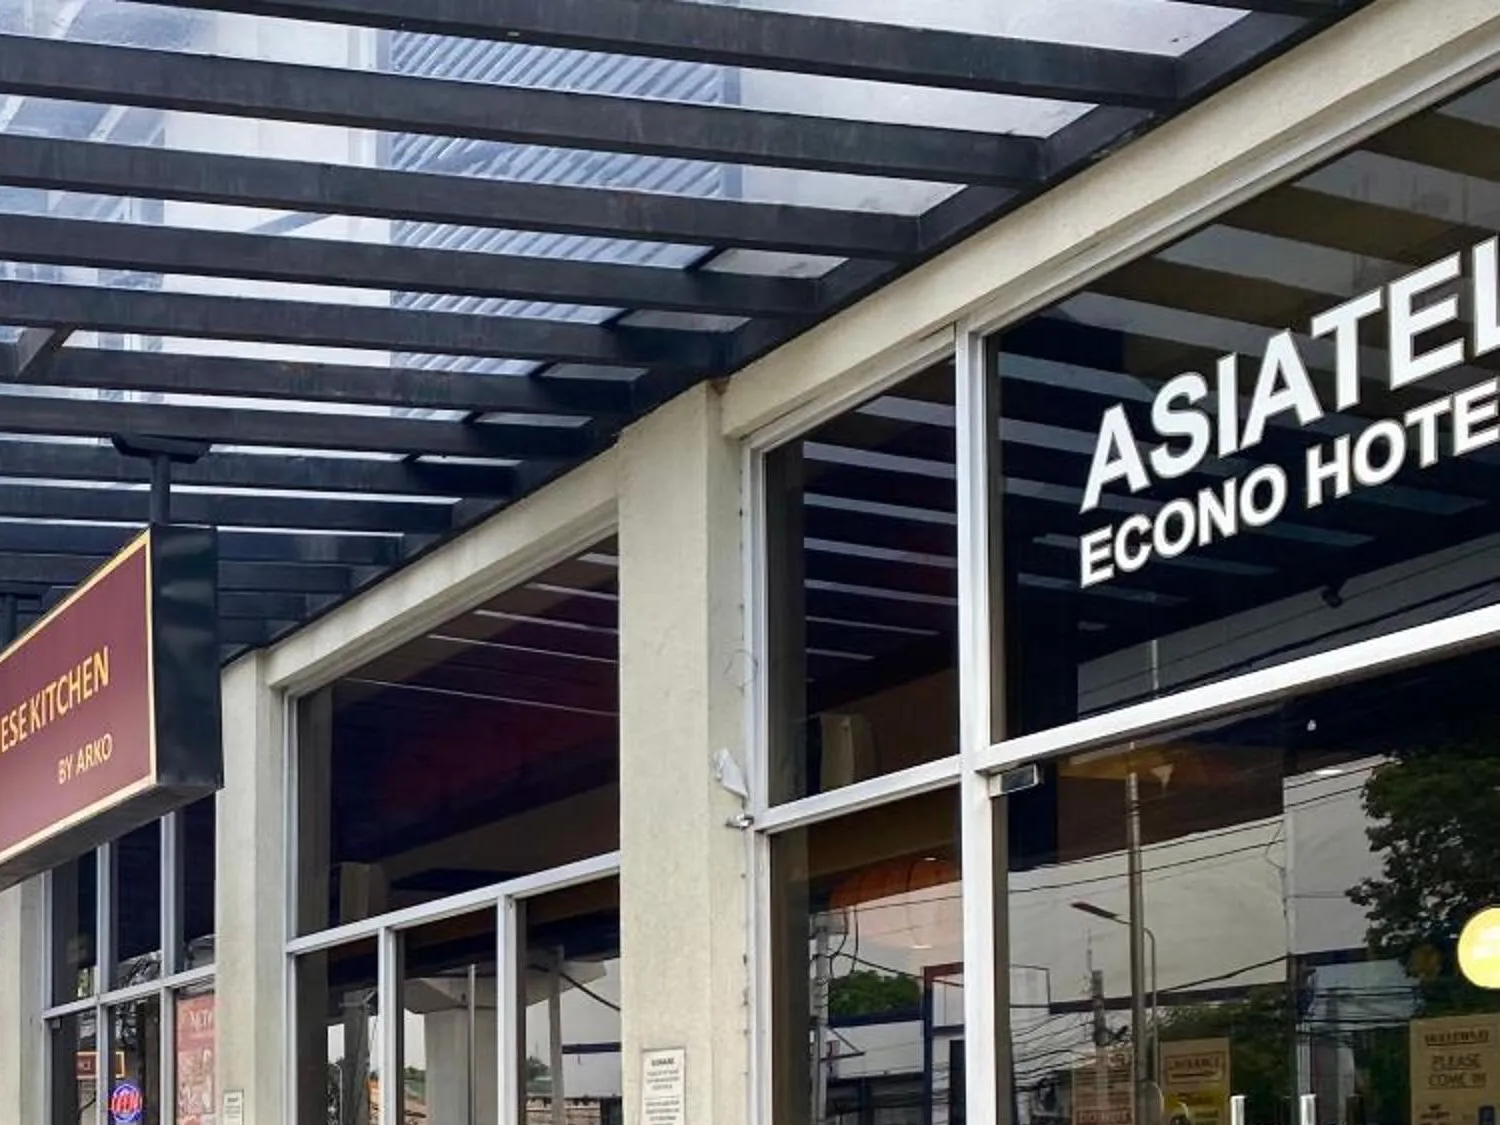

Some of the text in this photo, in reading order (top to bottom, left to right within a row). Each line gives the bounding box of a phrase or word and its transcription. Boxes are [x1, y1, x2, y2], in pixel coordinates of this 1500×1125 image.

[1079, 463, 1289, 589] ECONO
[28, 645, 110, 730] KITCHEN
[57, 733, 113, 785] BY ARKO
